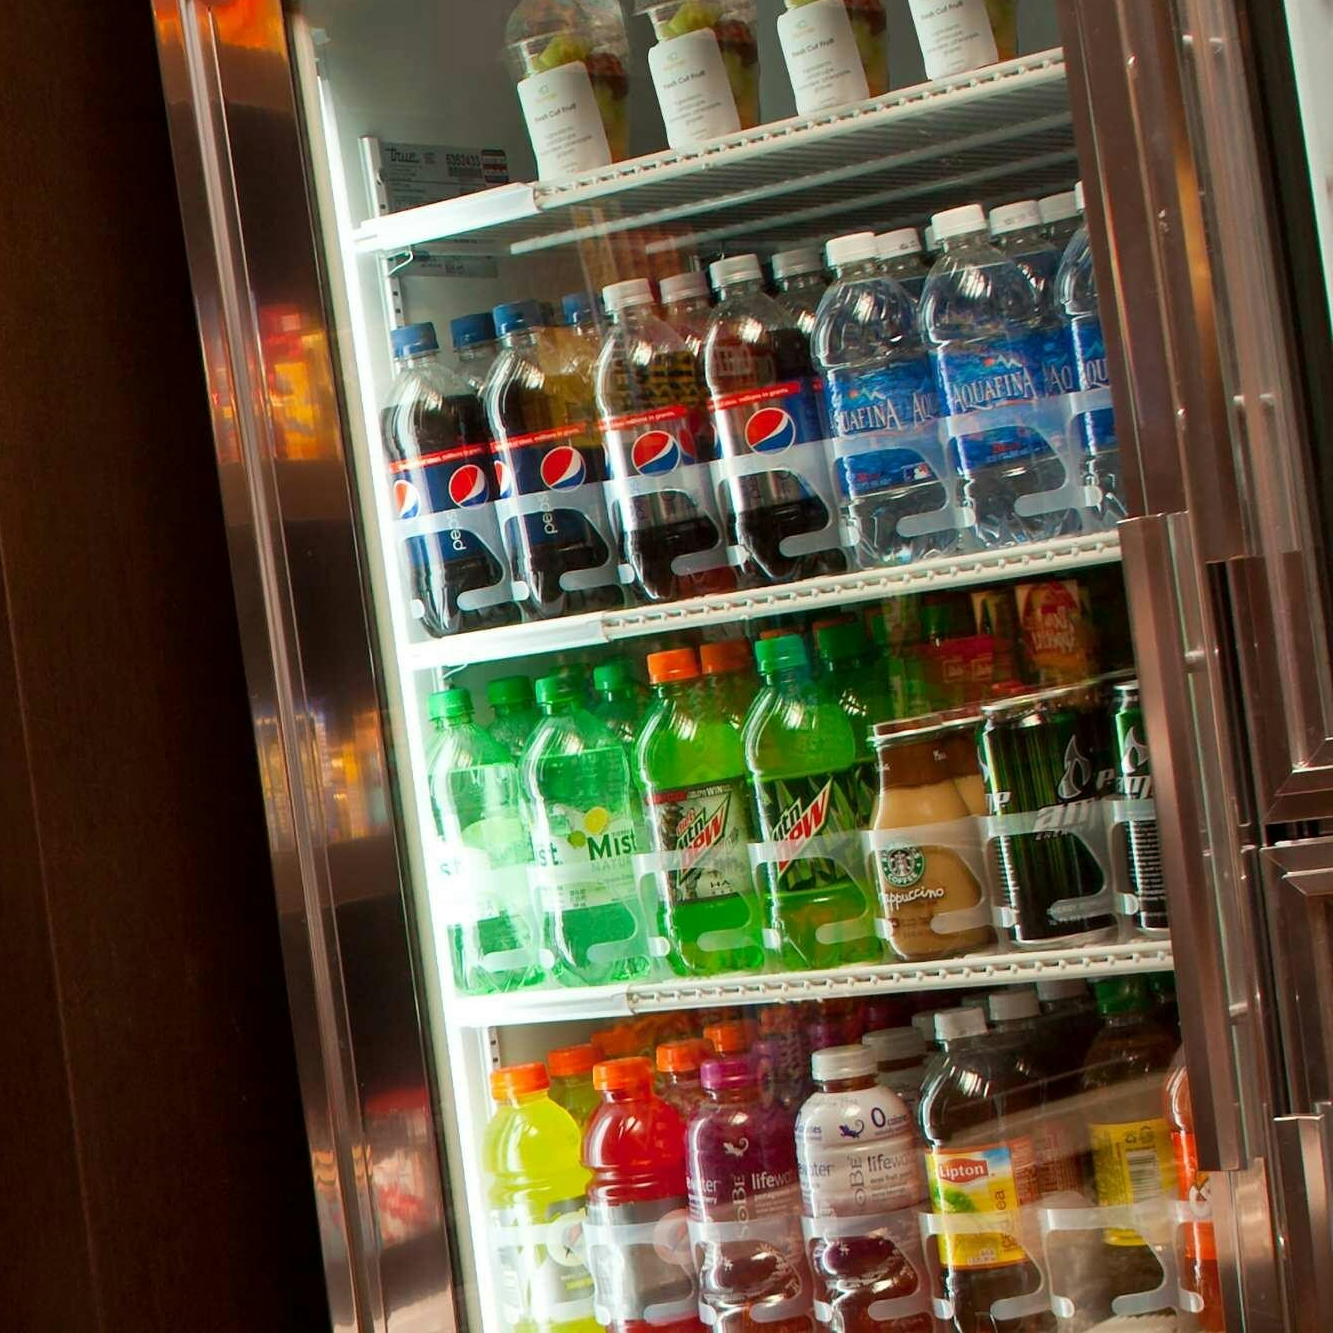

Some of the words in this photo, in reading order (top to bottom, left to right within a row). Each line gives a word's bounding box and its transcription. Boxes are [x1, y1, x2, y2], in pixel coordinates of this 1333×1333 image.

[951, 365, 1038, 412] AQUAFINA
[884, 886, 944, 911] appuccino
[938, 1162, 984, 1181] Lipton
